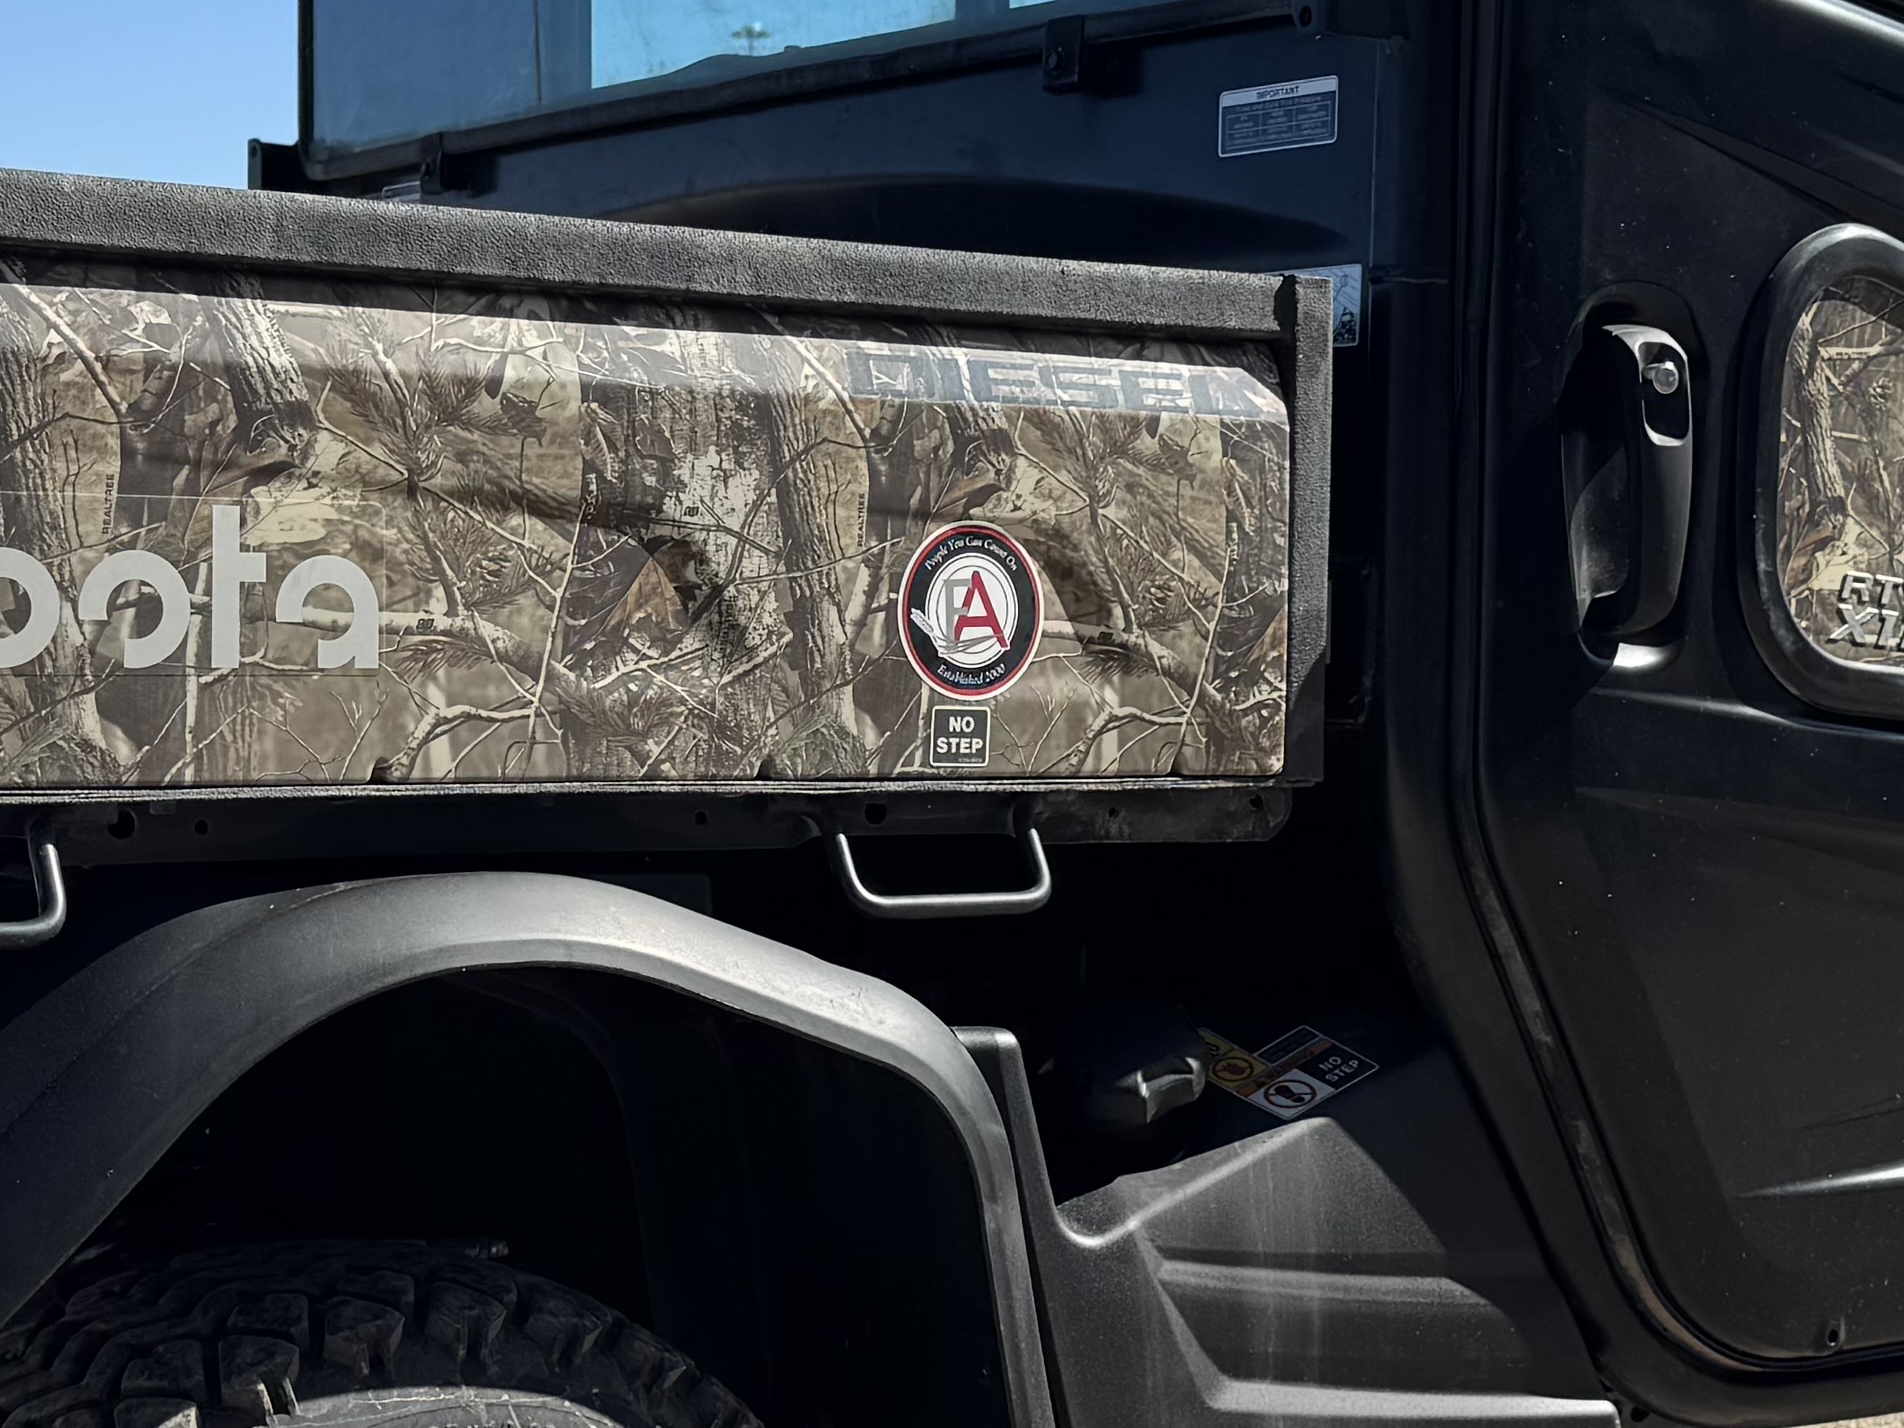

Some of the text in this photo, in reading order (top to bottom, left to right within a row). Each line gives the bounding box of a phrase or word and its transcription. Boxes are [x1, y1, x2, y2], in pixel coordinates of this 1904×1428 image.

[847, 349, 1261, 418] DIESEL
[102, 474, 114, 534] REALTREE
[949, 716, 975, 733] NO
[936, 737, 983, 754] STEP
[1319, 1055, 1342, 1071] NO
[1325, 1059, 1360, 1082] STEP
